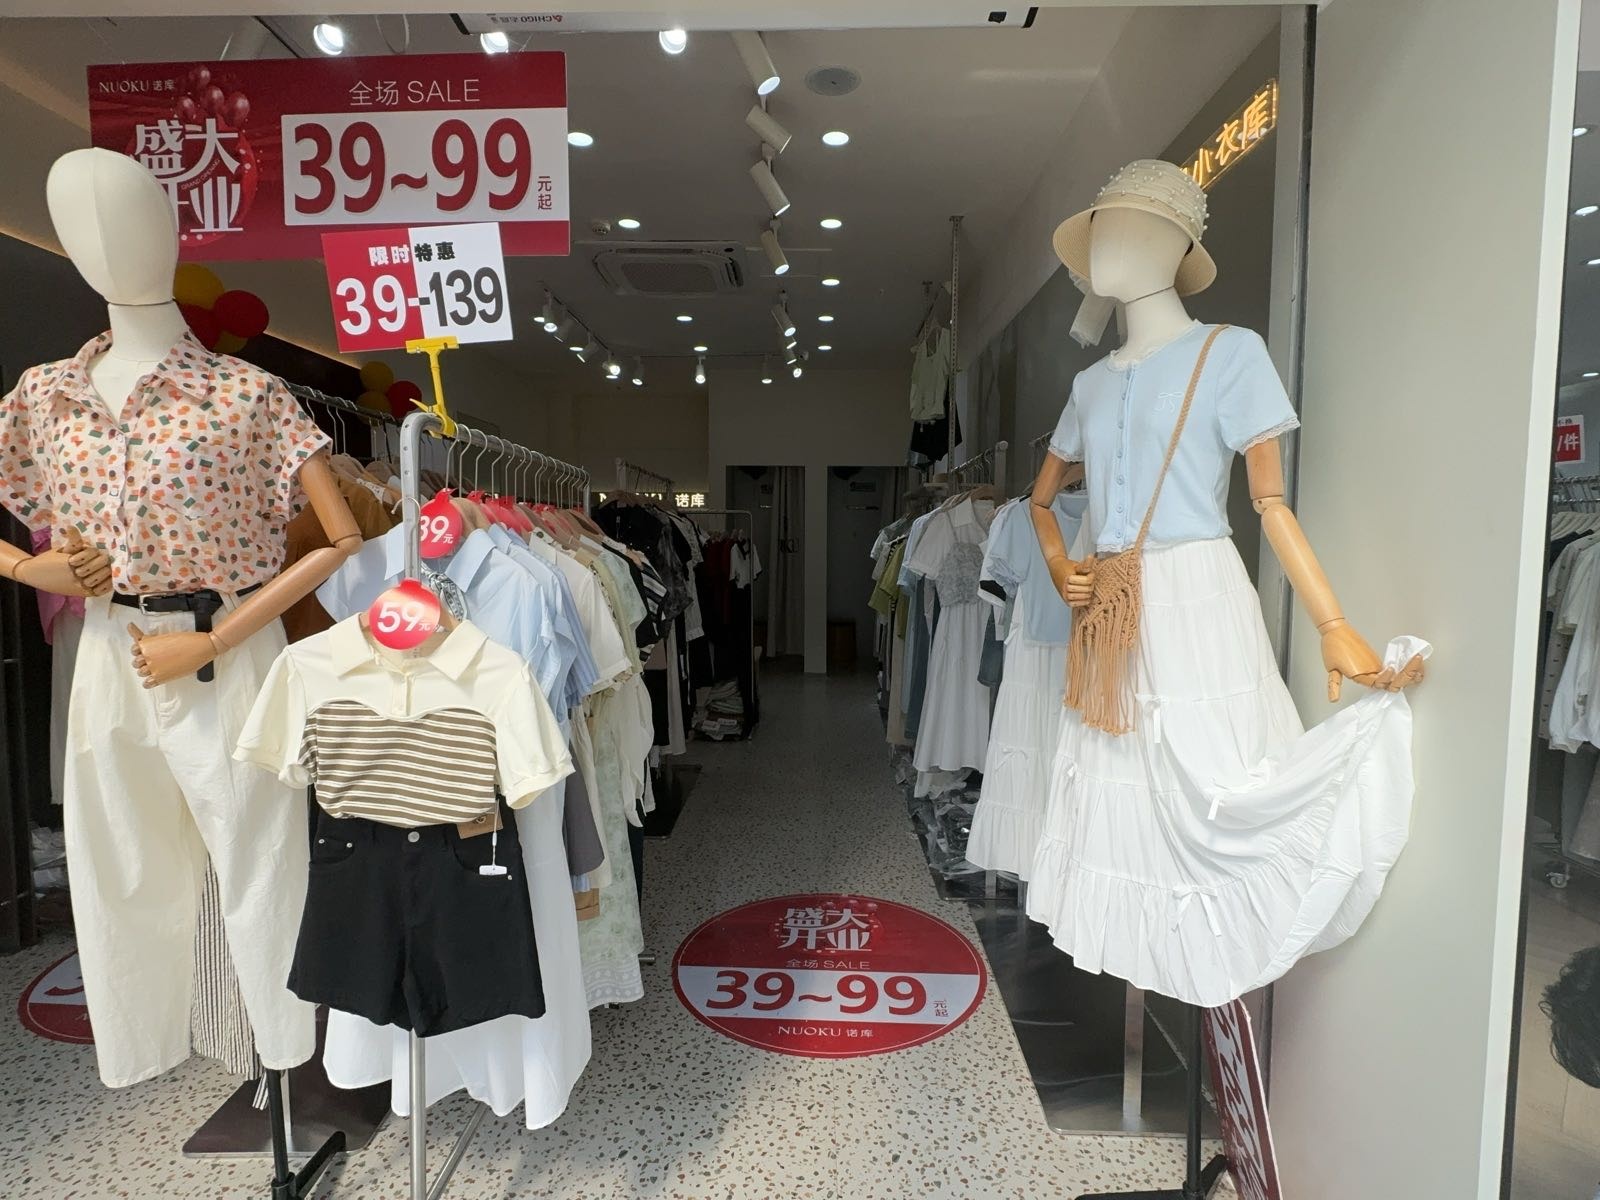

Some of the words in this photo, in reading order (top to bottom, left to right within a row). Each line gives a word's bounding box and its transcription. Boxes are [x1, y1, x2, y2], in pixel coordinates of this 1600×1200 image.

[100, 80, 150, 93] NUOKU
[153, 79, 175, 91] 诺库
[349, 80, 399, 106] 全场
[407, 79, 480, 103] SALE
[134, 118, 241, 184] 盛大
[1181, 90, 1269, 186] 小衣库
[292, 118, 532, 214] 39~99
[537, 175, 552, 210] 元起
[368, 241, 456, 267] 限时特惠
[336, 266, 504, 335] 39-139
[675, 493, 705, 508] 诺库
[783, 907, 870, 931] 盛大
[777, 926, 872, 951] 开业
[785, 959, 819, 969] 全场
[823, 960, 871, 970] SALE
[706, 970, 927, 1016] 39~99
[933, 999, 949, 1017] 元起
[778, 1026, 841, 1037] NUOKU
[846, 1029, 873, 1038] 诺库
